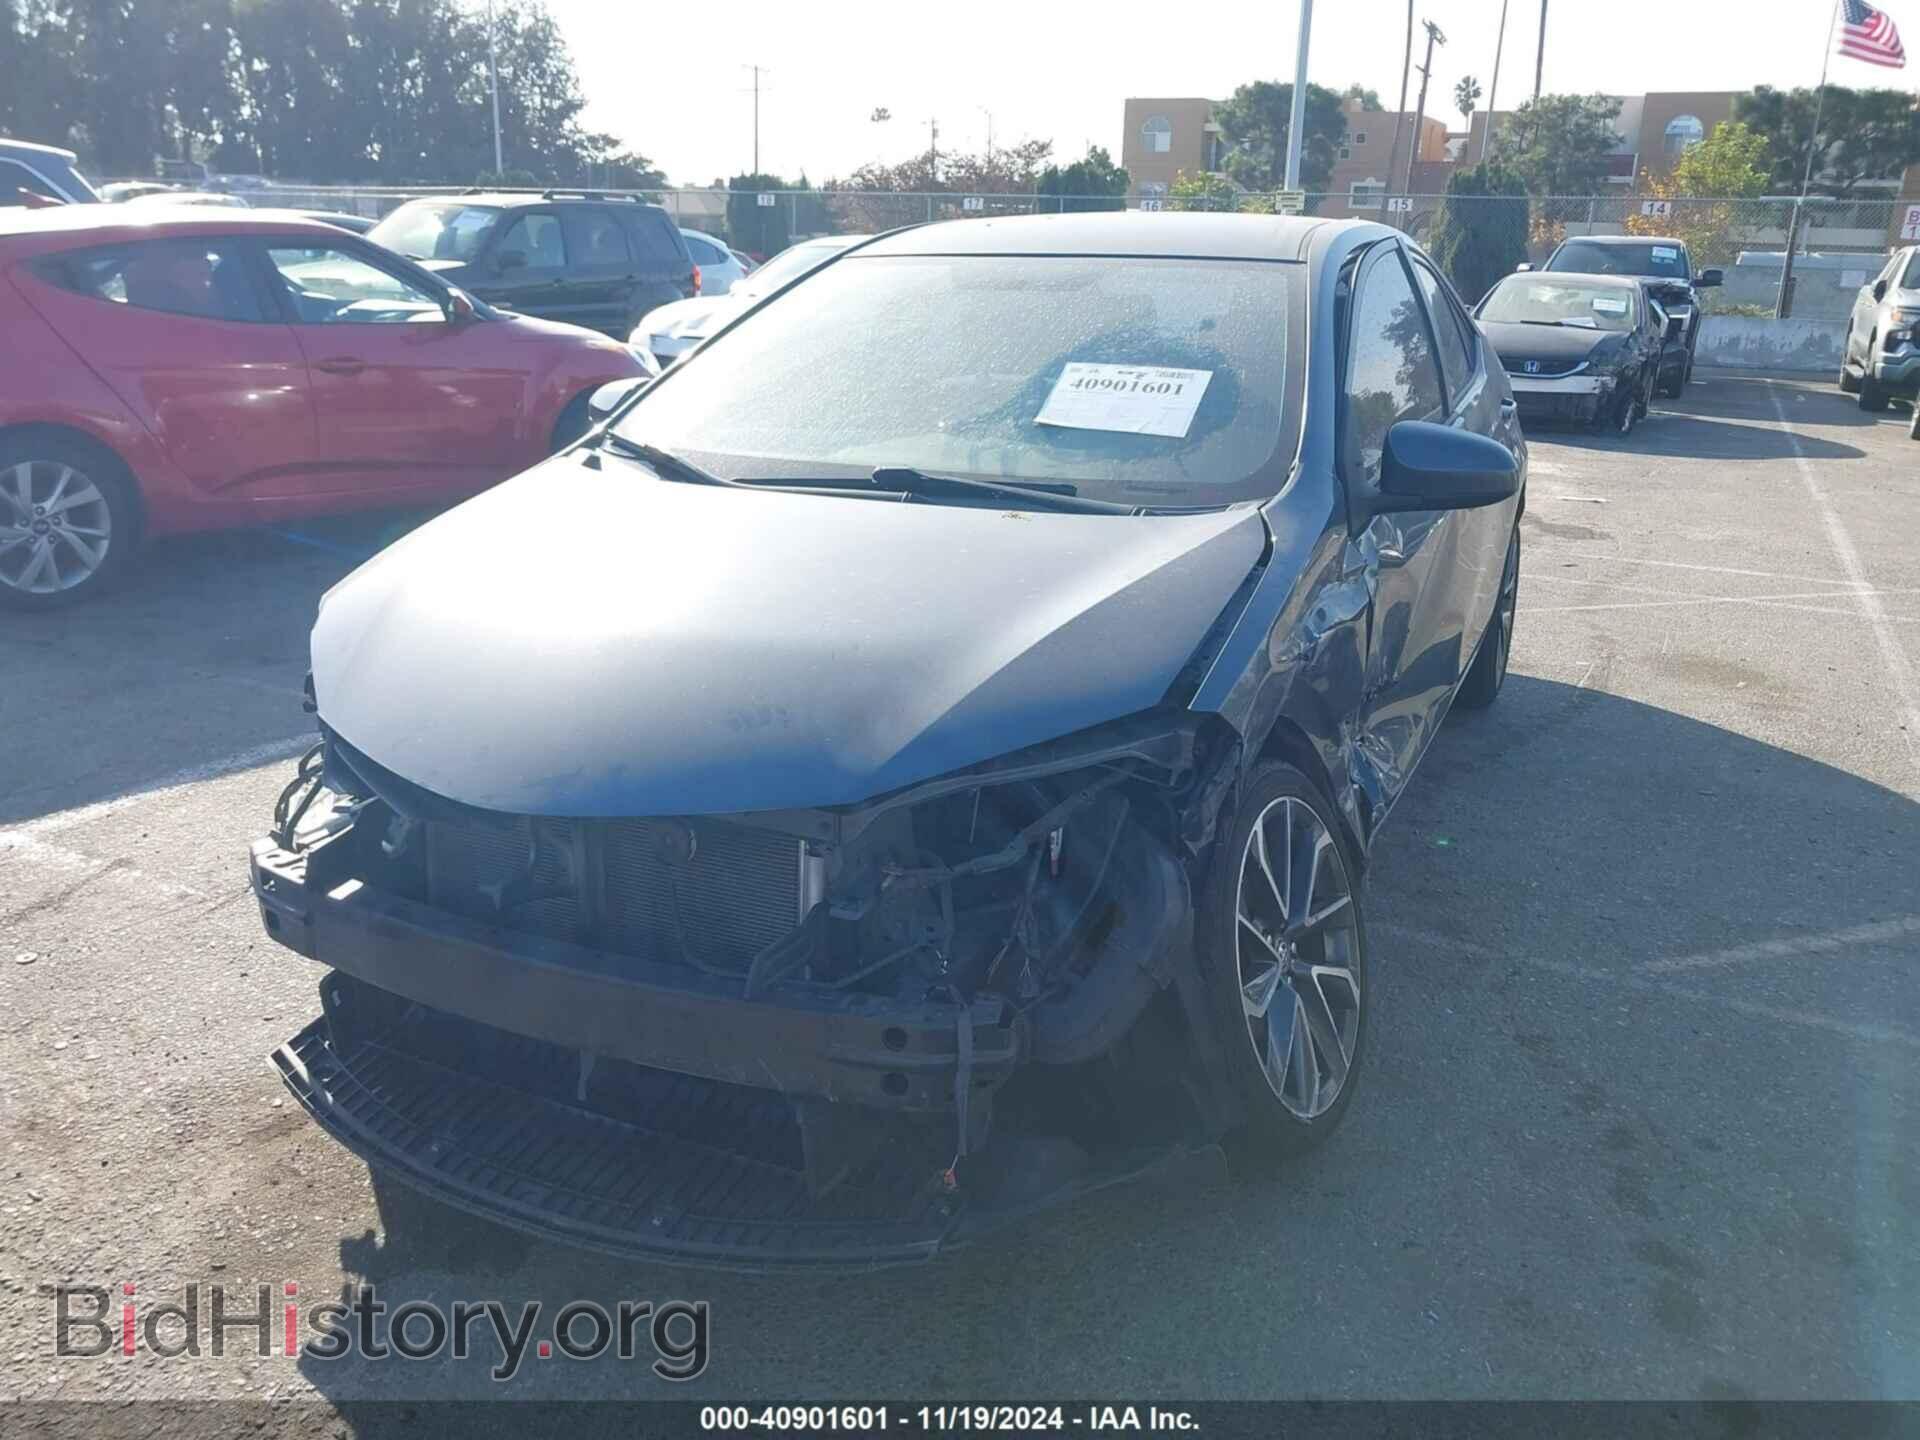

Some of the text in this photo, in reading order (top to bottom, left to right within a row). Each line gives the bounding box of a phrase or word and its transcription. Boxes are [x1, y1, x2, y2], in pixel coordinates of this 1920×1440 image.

[1393, 199, 1408, 210] 15
[1647, 202, 1665, 214] 14
[1070, 377, 1184, 395] 40901601
